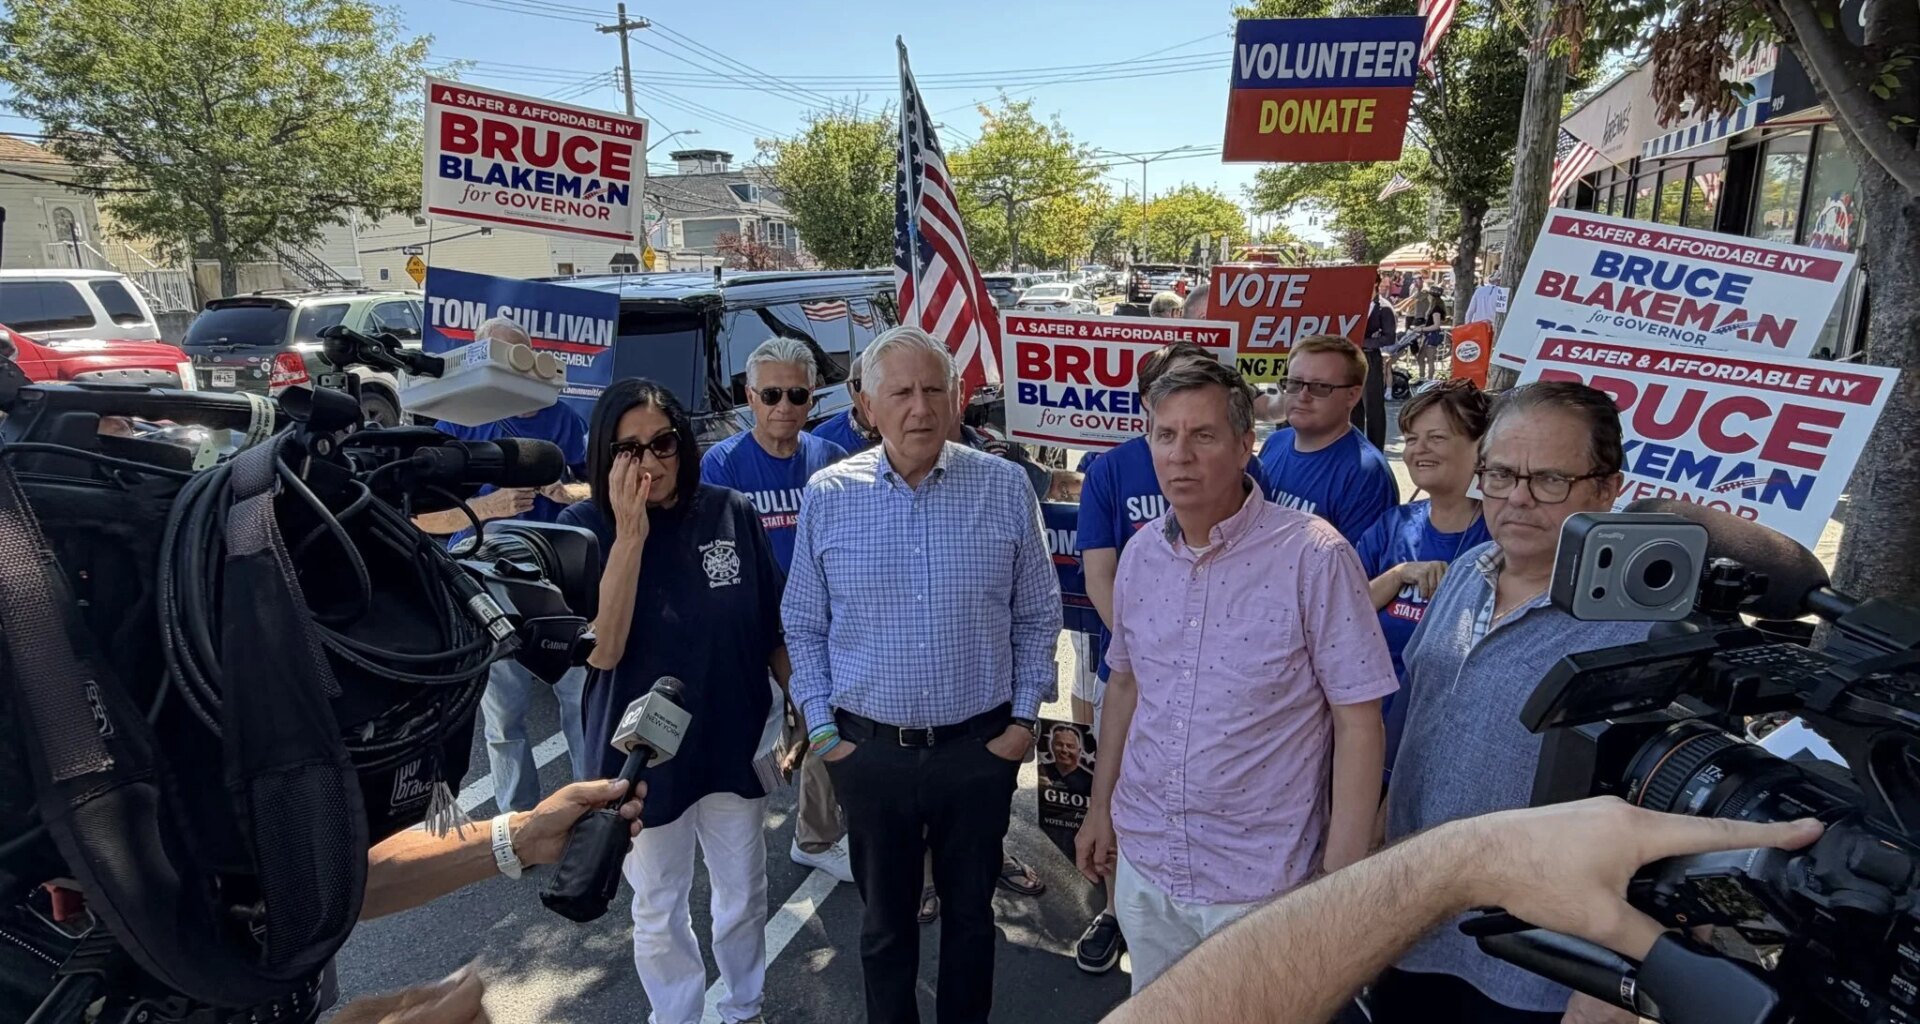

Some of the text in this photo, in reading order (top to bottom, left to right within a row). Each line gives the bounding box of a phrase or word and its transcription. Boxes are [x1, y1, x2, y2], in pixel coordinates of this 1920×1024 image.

[1239, 41, 1415, 79] VOLUNTEER
[441, 90, 634, 136] A SAFER & AFFORDABLE NY
[1259, 99, 1376, 134] DONATE
[441, 111, 633, 181] BRUCE
[439, 154, 630, 206] BLAKEMAN
[458, 184, 491, 205] for
[495, 190, 610, 221] GOVERNOR
[1568, 222, 1816, 274] A SAFER & AFFORDABLE NY
[1219, 273, 1310, 308] VOTE
[1591, 250, 1753, 305] BRUCE
[428, 296, 487, 330] TOM
[1535, 270, 1797, 349] BLAKEMAN
[1586, 309, 1612, 324] for
[1613, 316, 1707, 346] GOVERNOR
[1015, 321, 1219, 344] A SAFER & AFFORDABLE NY
[1016, 342, 1155, 388] BRU
[1550, 345, 1861, 397] A SAFER & AFFORDABLE NY
[1037, 409, 1066, 428] for
[762, 516, 785, 527] STATE
[1394, 603, 1421, 620] STATE
[541, 639, 569, 649] Canon
